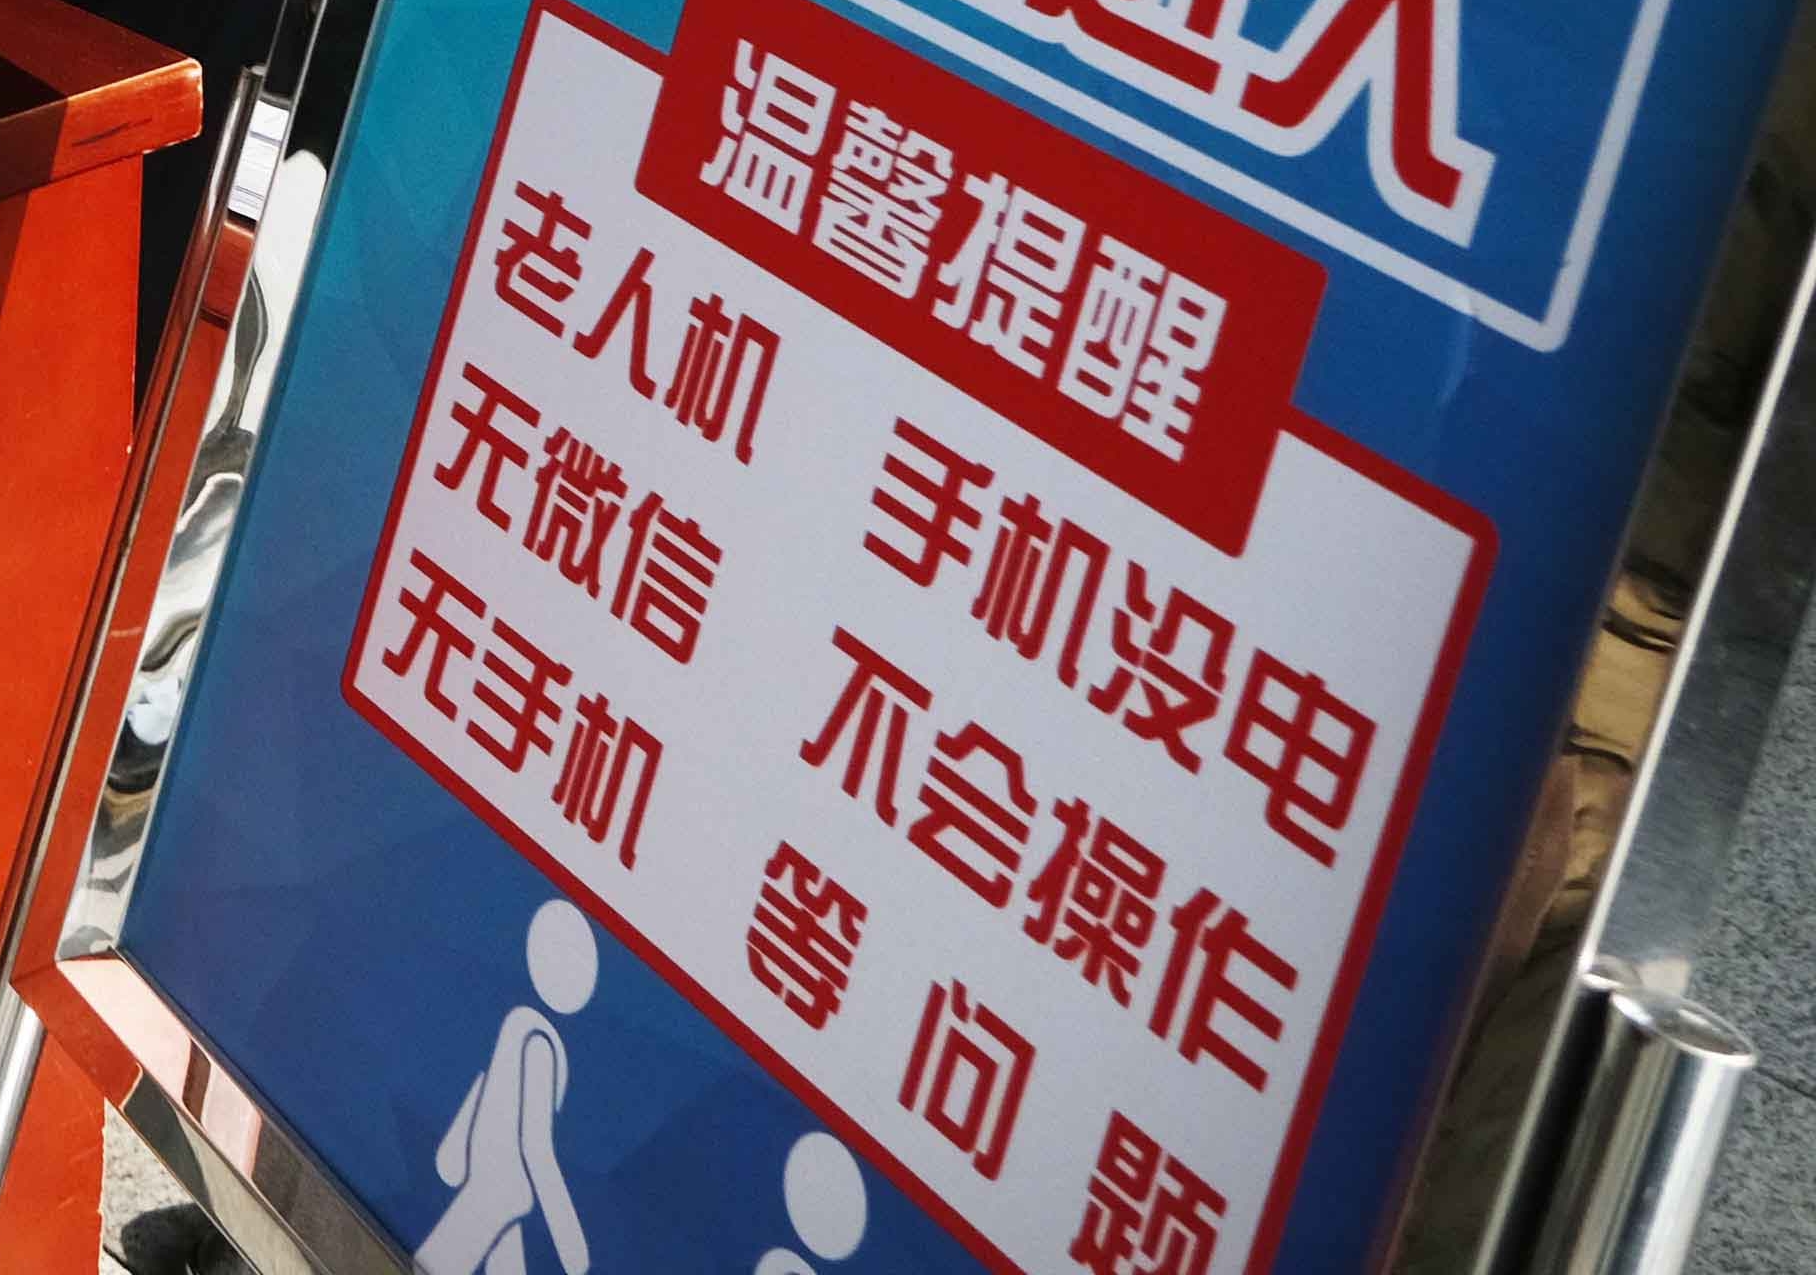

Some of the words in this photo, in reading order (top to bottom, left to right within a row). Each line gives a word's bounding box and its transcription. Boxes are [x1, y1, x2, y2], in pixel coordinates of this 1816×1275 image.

[494, 180, 782, 466] 老人机
[864, 417, 1378, 869] 手机没电
[700, 39, 1228, 463] 温馨提醒
[383, 547, 665, 870] 无手机
[433, 362, 724, 665] 无微信
[800, 626, 1298, 1092] 不会操作
